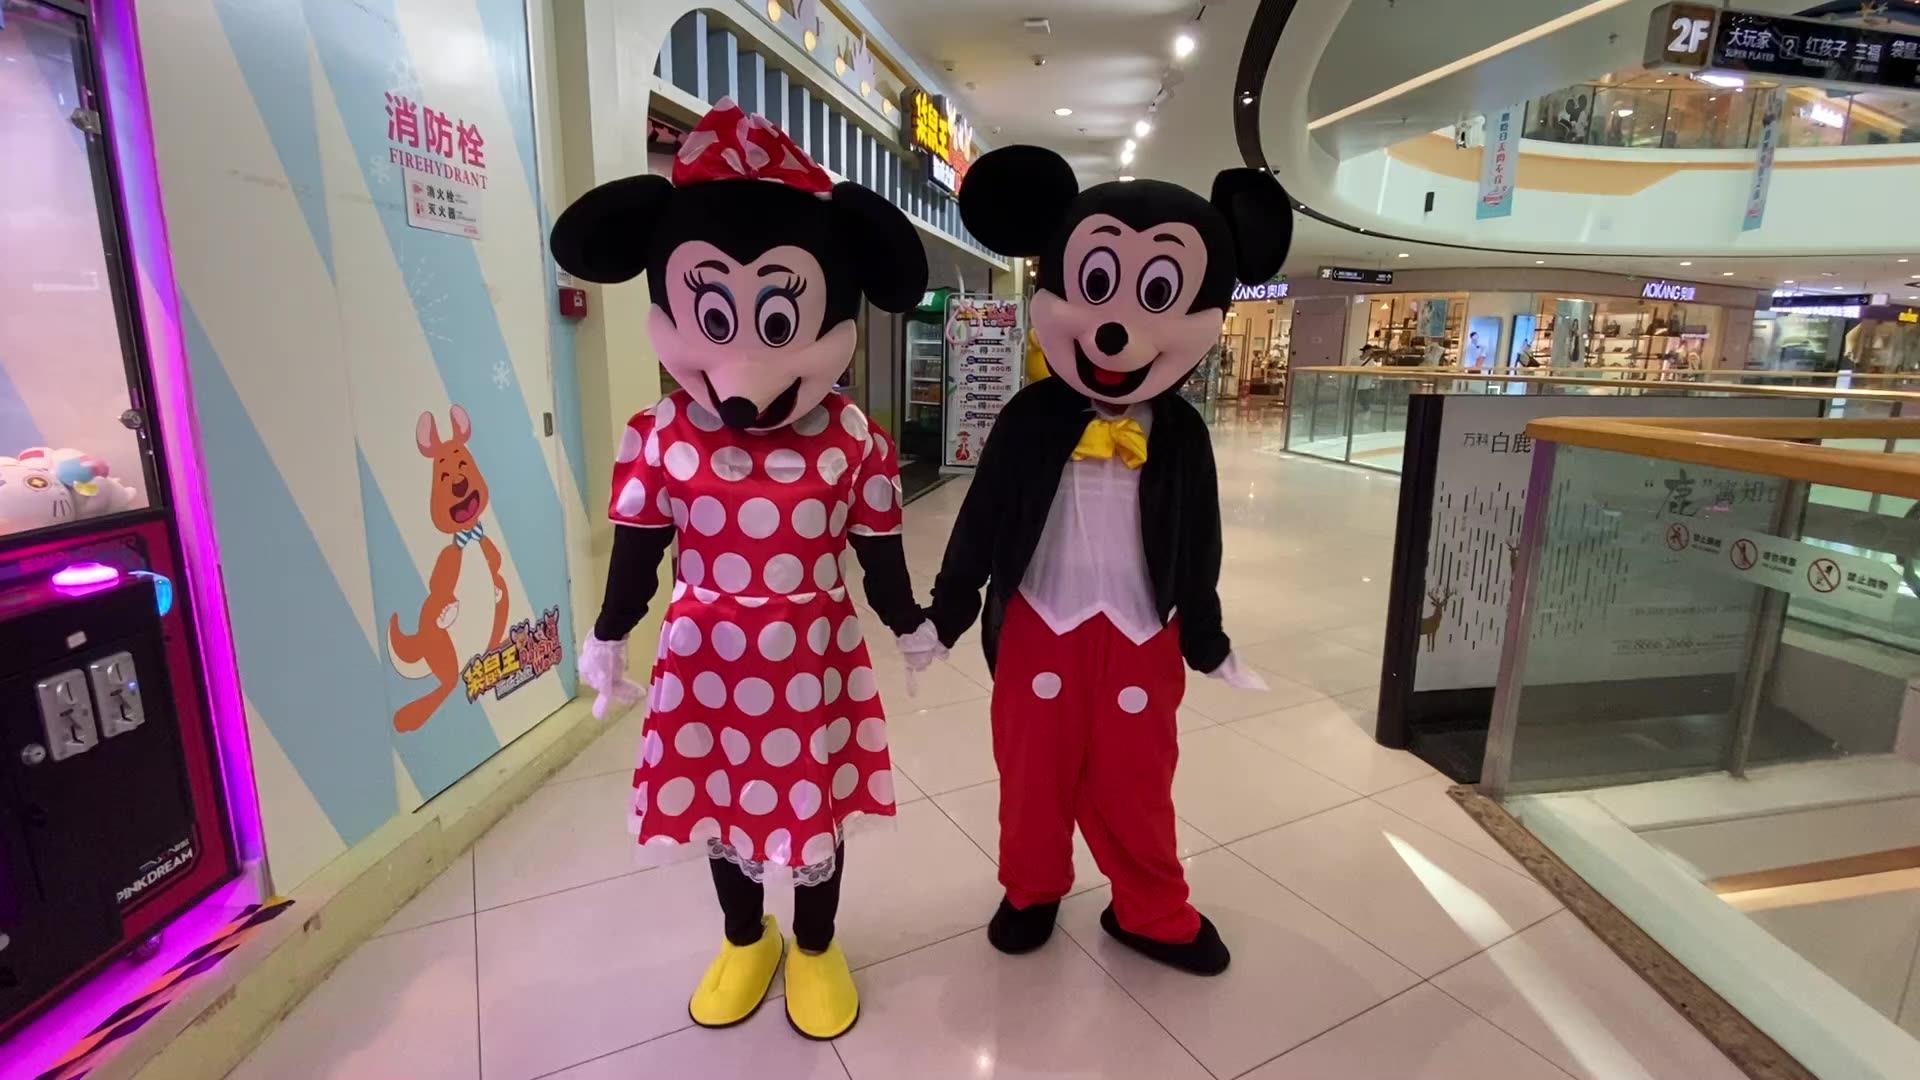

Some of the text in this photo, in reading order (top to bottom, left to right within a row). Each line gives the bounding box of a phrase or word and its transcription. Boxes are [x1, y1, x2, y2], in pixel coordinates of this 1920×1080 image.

[1668, 17, 1710, 53] 2F
[1728, 29, 1772, 49] 大玩家
[1805, 36, 1847, 58] 红孩子
[1852, 42, 1882, 62] 三福
[384, 91, 486, 168] 消防栓
[389, 147, 488, 189] FIREHYDRANT
[1267, 284, 1289, 298] 奥康
[1642, 280, 1680, 300] AOKANG
[1463, 432, 1489, 447] 万科
[116, 847, 193, 903] PINKDREAM
